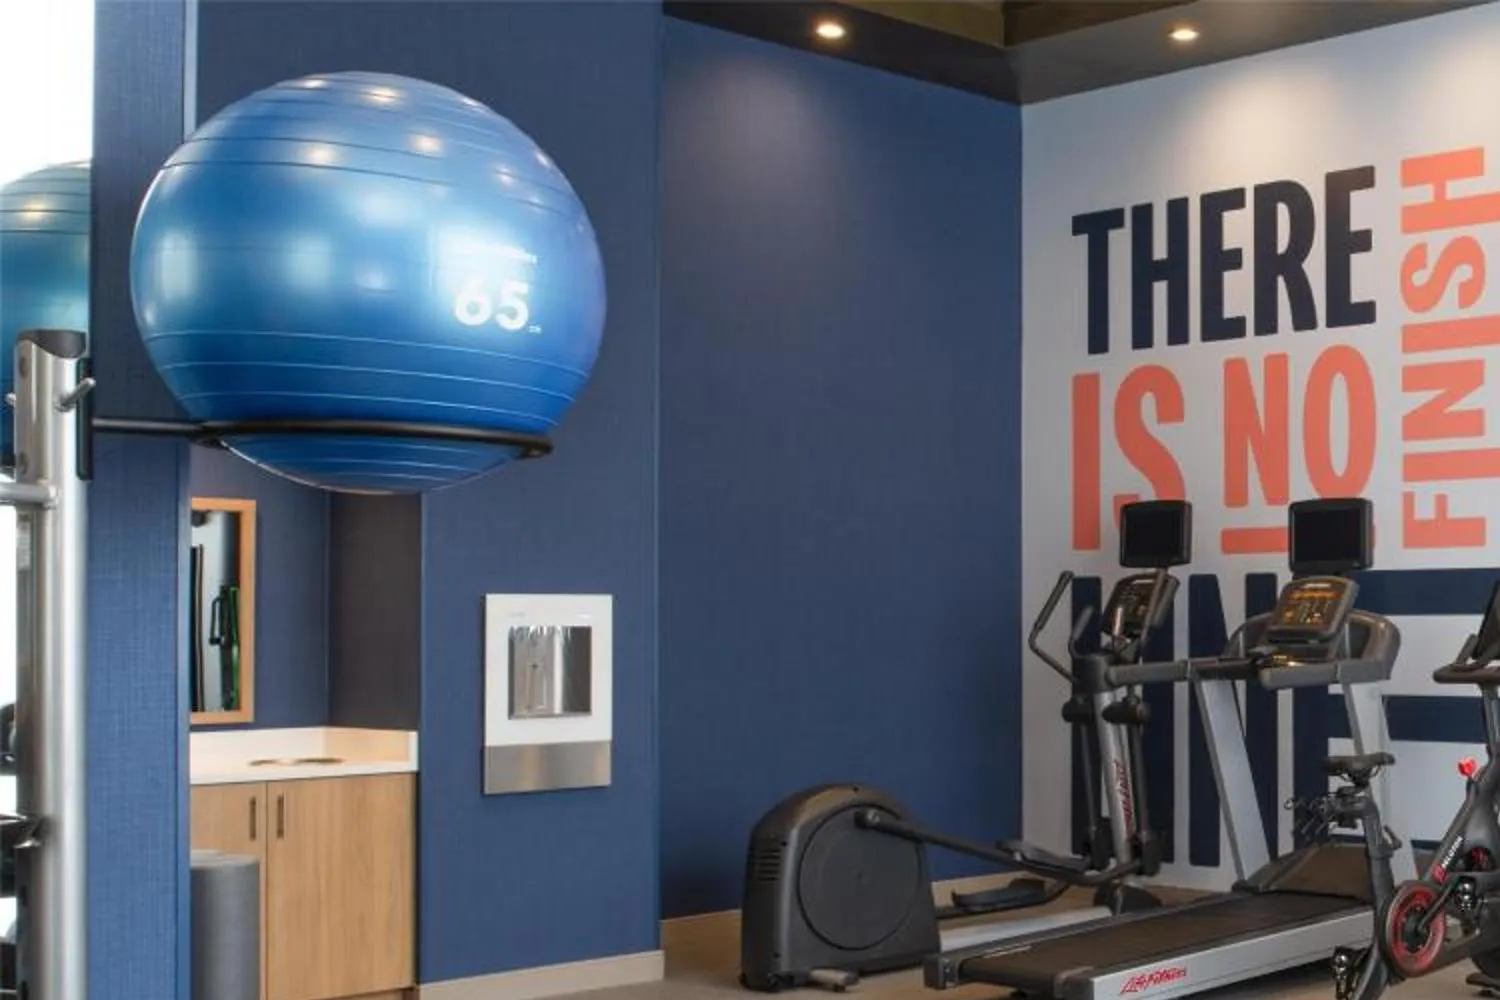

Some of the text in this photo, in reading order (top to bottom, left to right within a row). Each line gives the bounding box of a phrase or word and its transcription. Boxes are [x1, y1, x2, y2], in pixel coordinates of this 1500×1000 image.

[455, 276, 530, 331] 65
[1072, 165, 1376, 355] THERE
[1400, 146, 1485, 549] FINISH
[1072, 344, 1377, 551] IS NO
